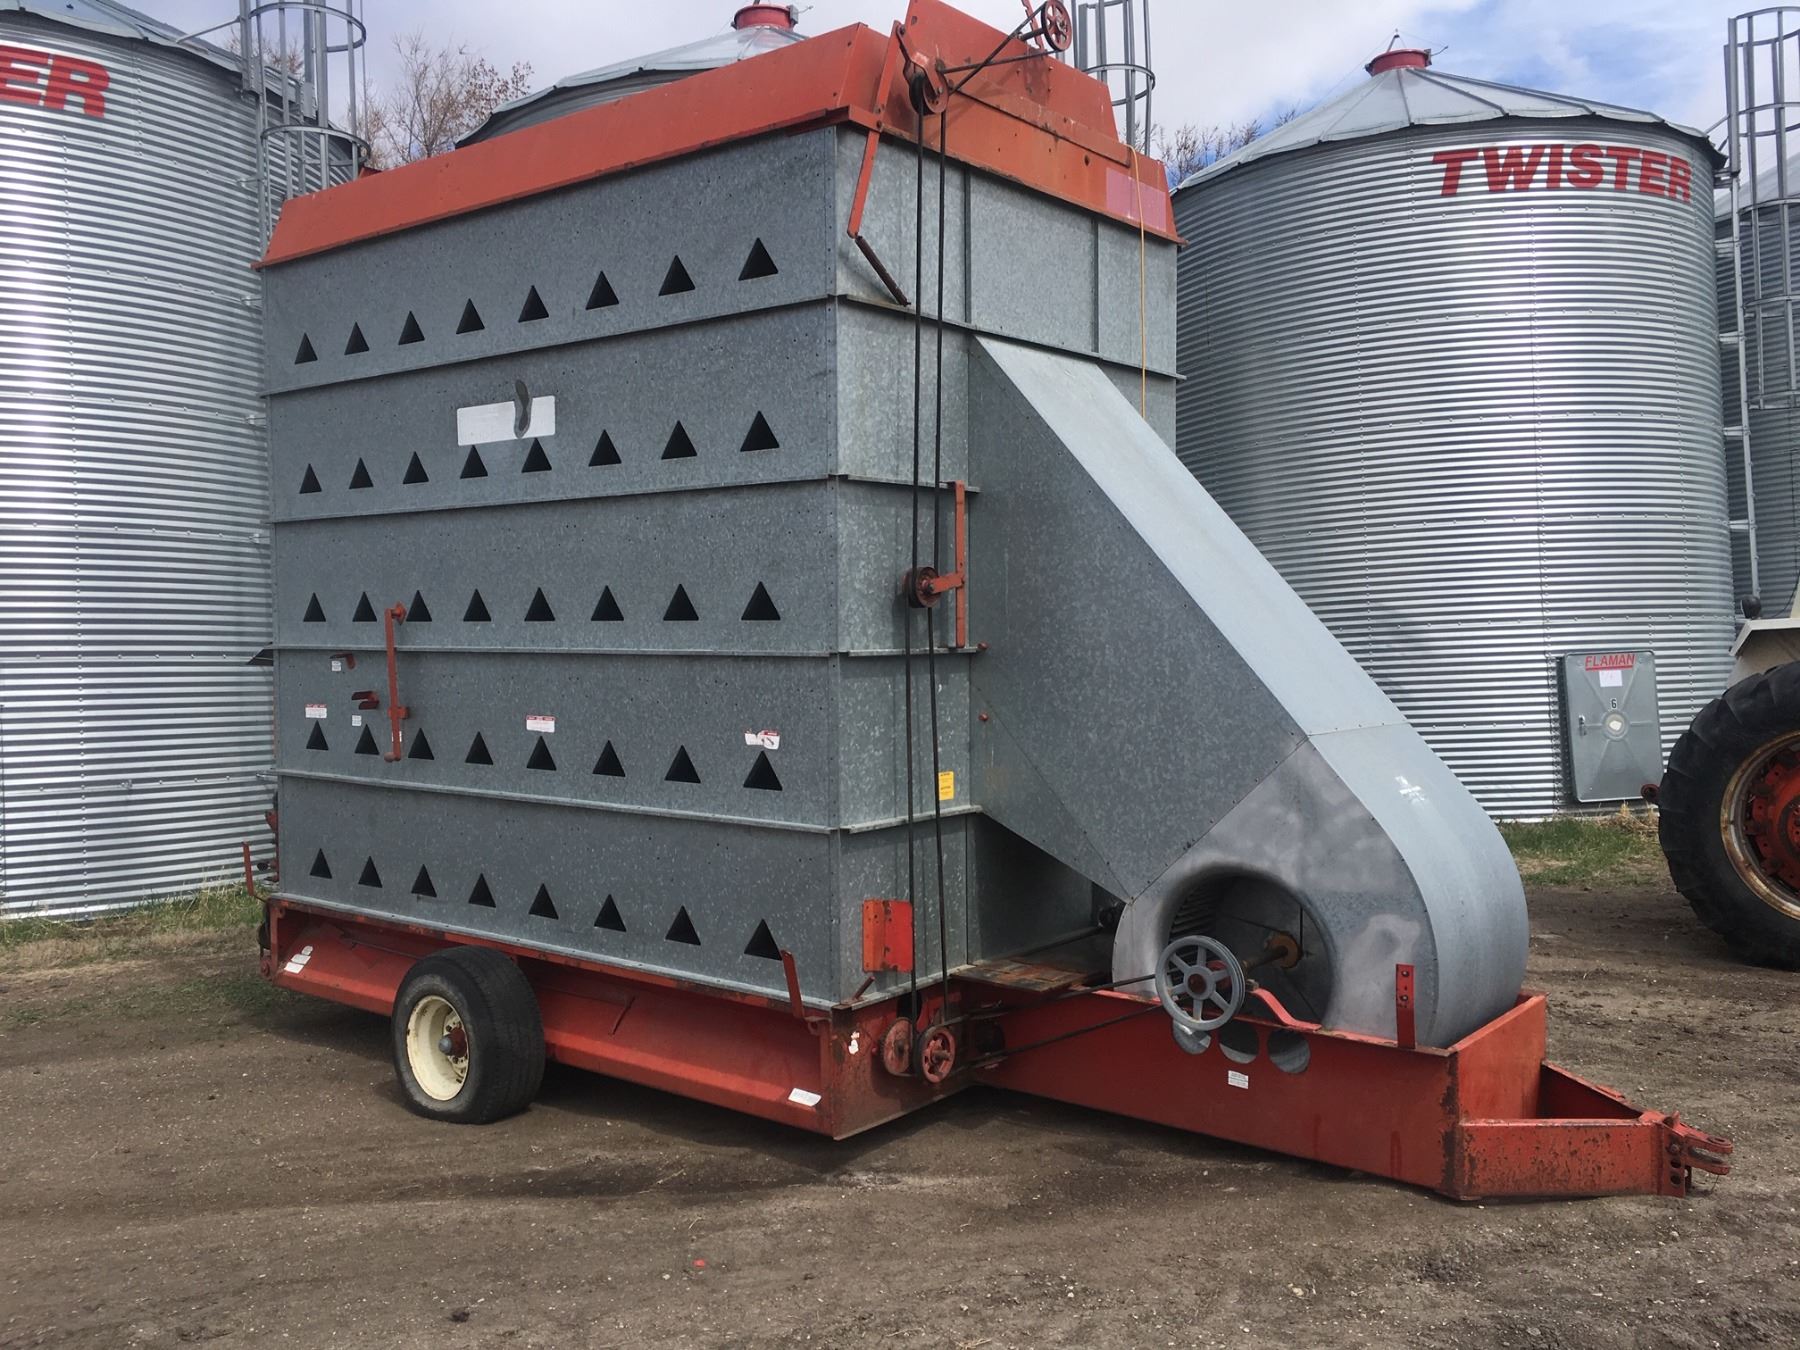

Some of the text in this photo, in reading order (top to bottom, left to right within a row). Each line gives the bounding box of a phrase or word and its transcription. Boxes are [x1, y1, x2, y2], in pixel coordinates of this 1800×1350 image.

[1433, 144, 1691, 203] TWISTER
[1585, 653, 1635, 668] FLAMAN
[1610, 698, 1618, 709] 6
